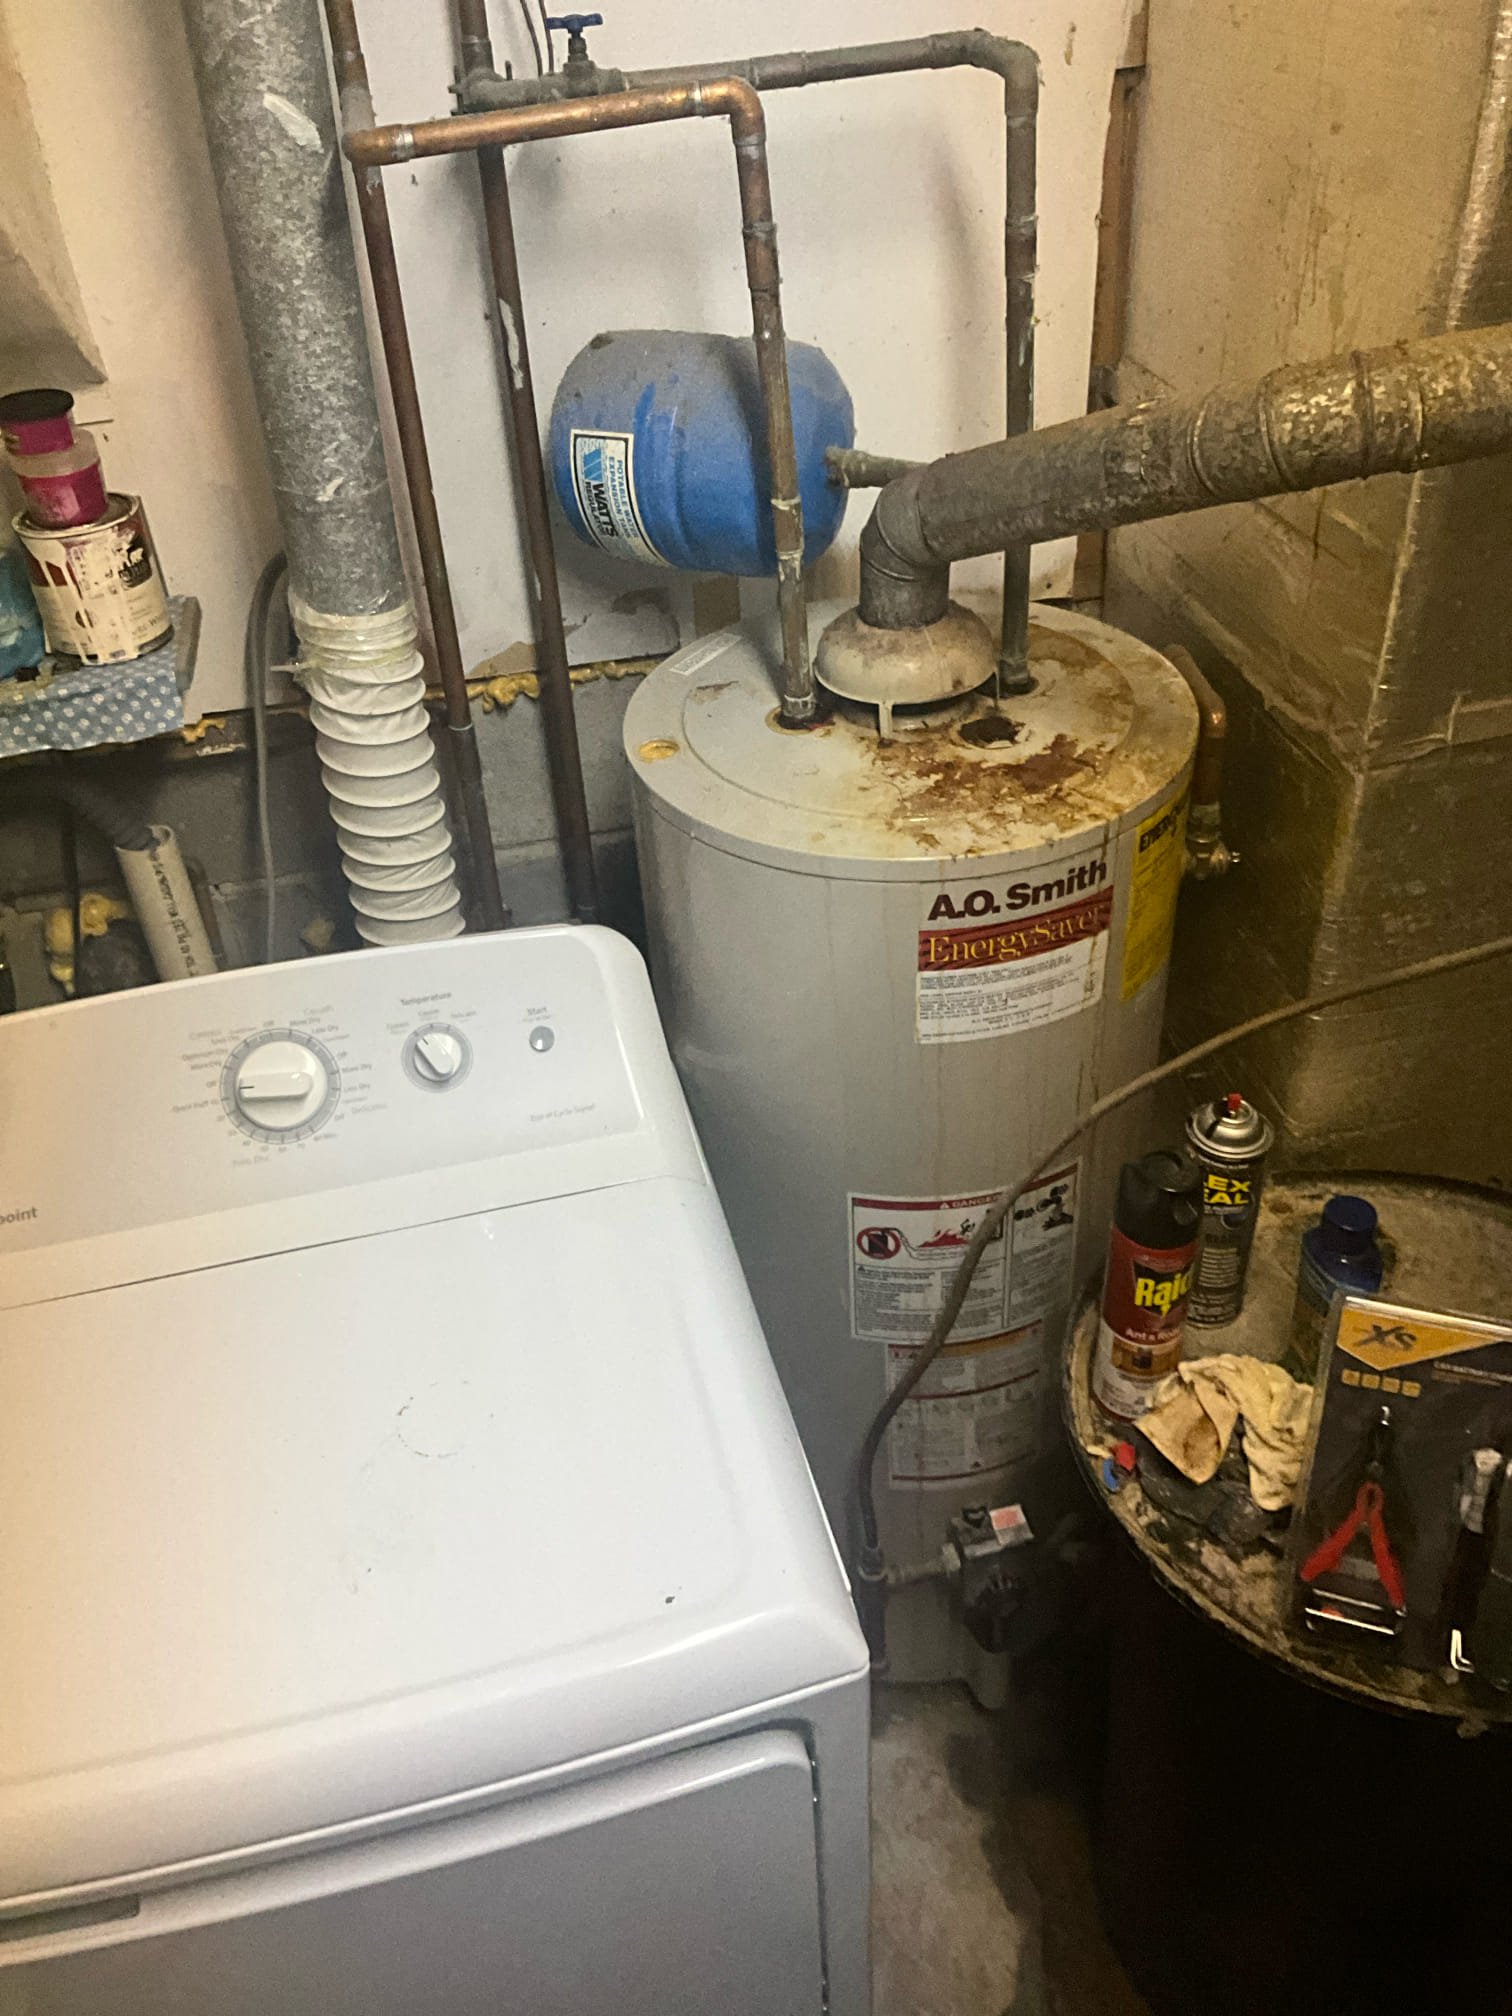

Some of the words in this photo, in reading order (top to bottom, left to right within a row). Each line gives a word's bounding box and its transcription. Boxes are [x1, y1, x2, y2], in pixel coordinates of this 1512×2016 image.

[592, 483, 619, 537] WATTS
[608, 456, 623, 515] EXPANSION
[618, 518, 631, 538] TANK
[617, 459, 627, 507] POTABLE
[624, 509, 639, 538] WATER
[927, 889, 1000, 921] A.O.
[1006, 859, 1107, 911] Smith
[400, 991, 452, 1006] Temperature
[526, 1006, 548, 1016] Start
[1203, 1174, 1252, 1193] EX
